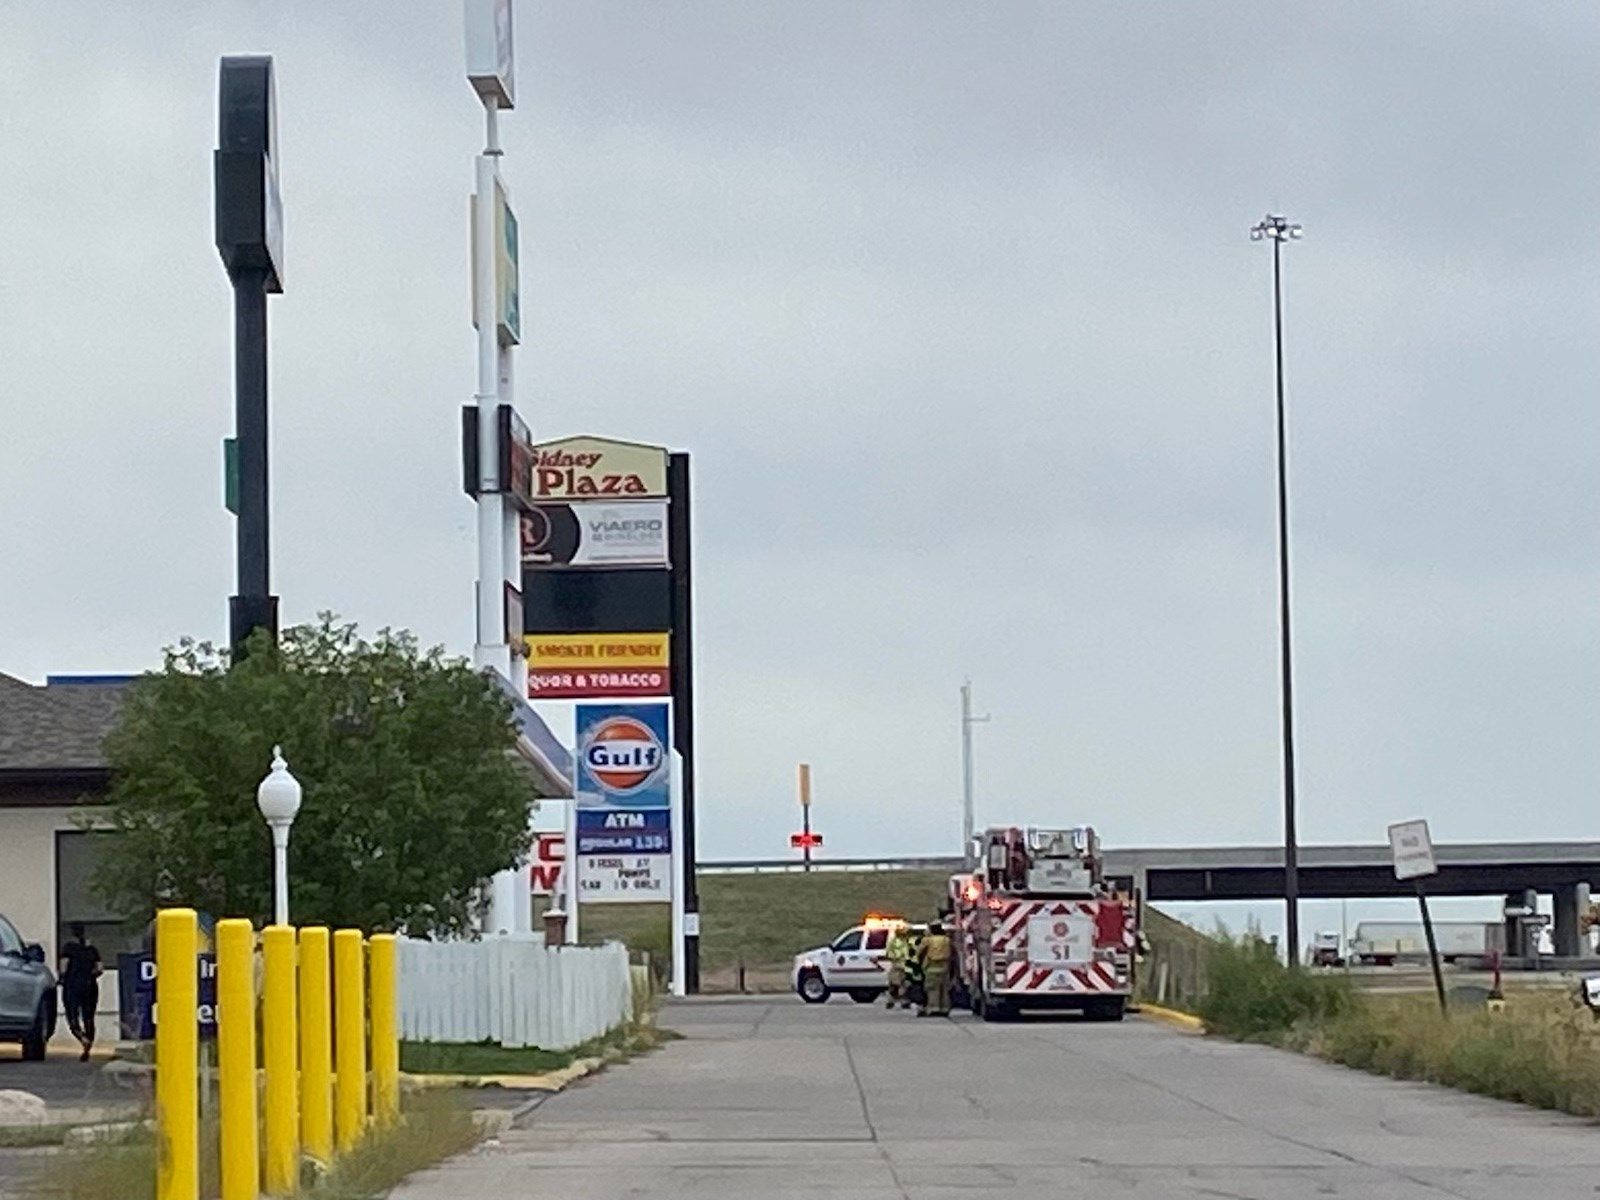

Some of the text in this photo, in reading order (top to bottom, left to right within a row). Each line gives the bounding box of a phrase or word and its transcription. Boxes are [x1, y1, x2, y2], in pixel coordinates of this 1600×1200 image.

[537, 468, 647, 495] Plaza
[589, 674, 661, 687] TOBACCO
[589, 746, 657, 767] Gulf
[605, 814, 645, 828] ATM
